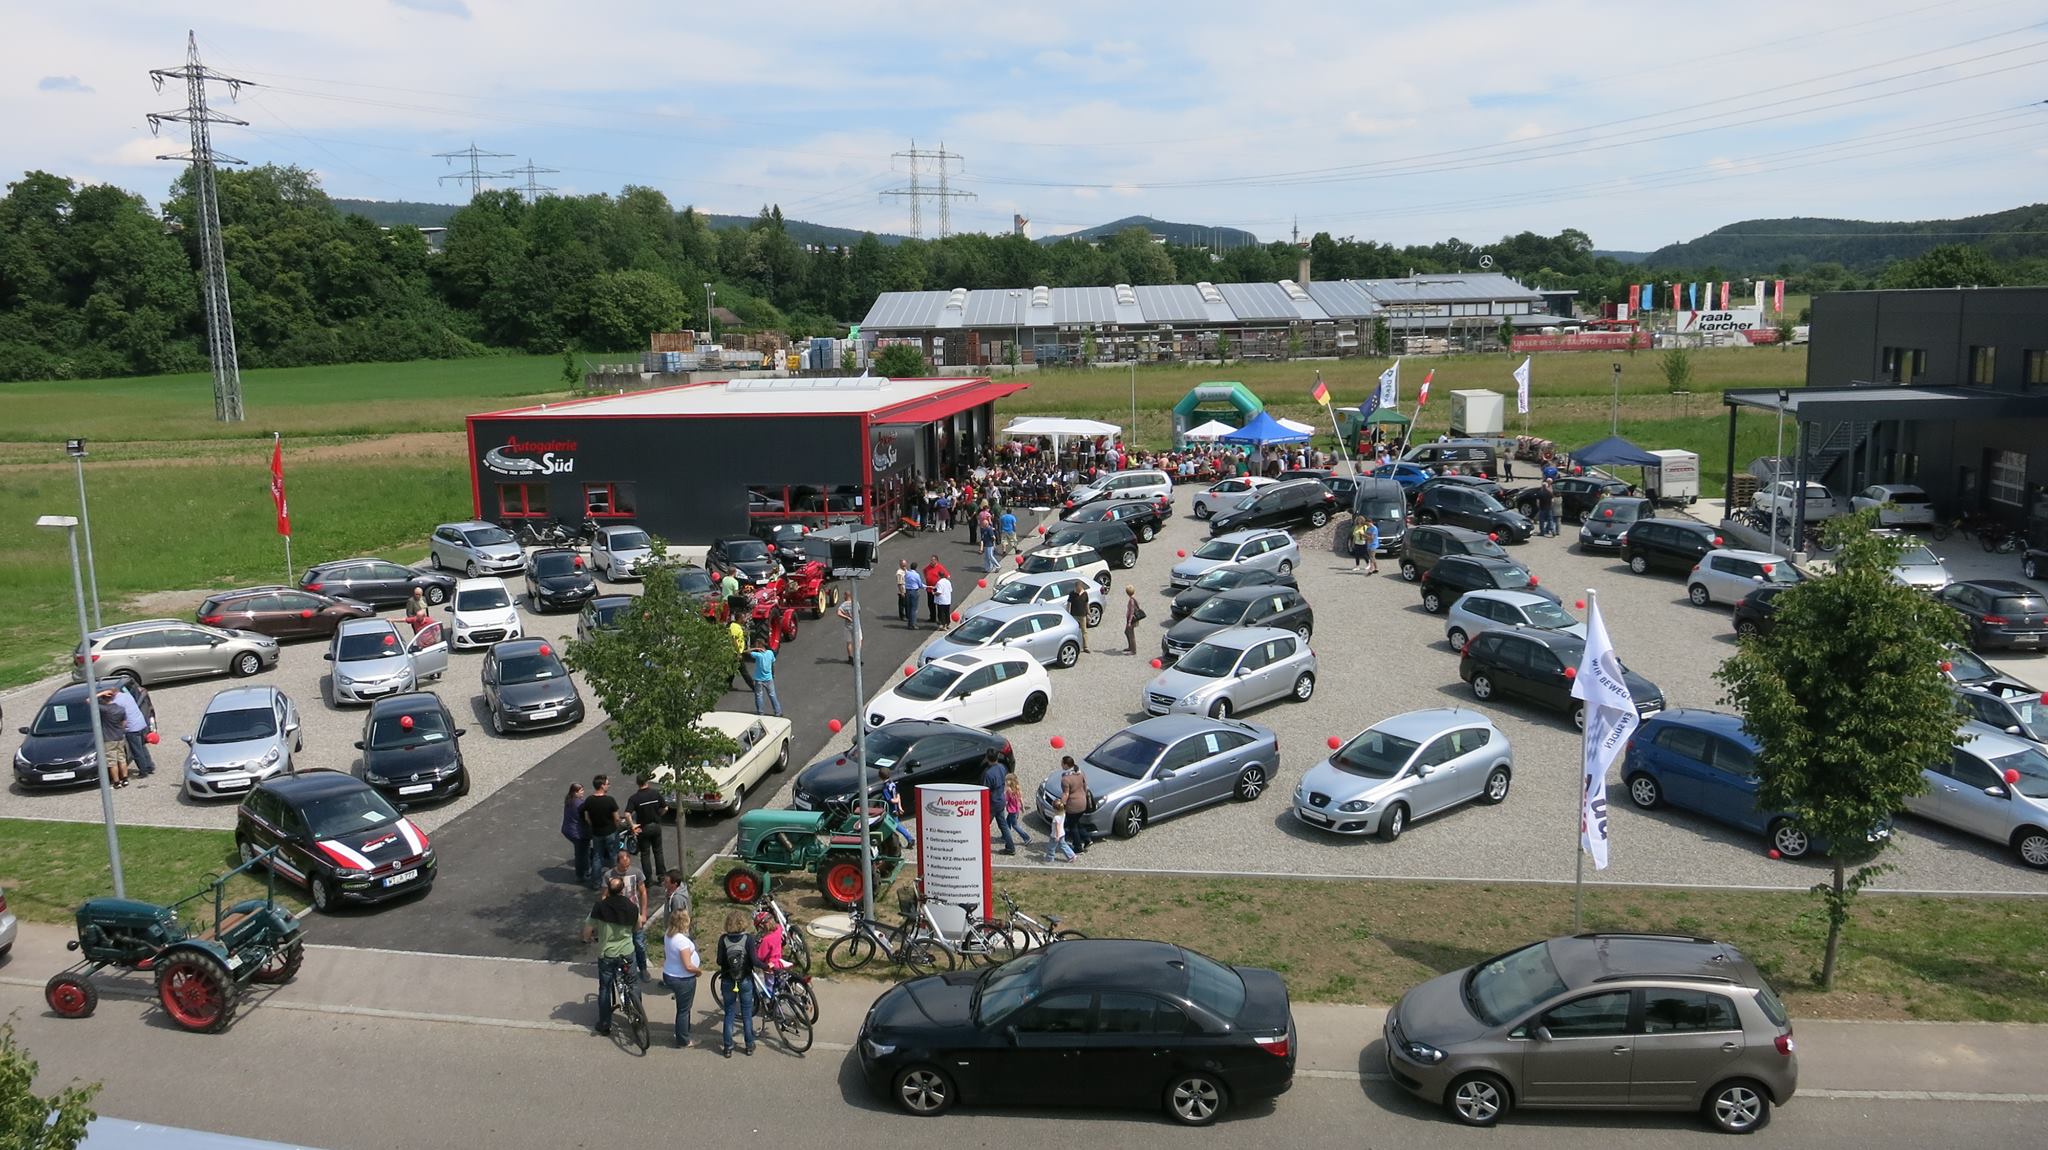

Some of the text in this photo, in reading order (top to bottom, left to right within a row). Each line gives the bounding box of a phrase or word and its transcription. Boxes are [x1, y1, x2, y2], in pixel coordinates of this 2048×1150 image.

[1701, 312, 1733, 321] raab
[1699, 322, 1753, 331] karcher
[1513, 339, 1538, 347] UNSER
[504, 435, 577, 454] Autogalerie
[542, 452, 574, 475] Süd
[1591, 658, 1603, 677] WIR
[937, 796, 978, 807] Autogalerie
[956, 806, 975, 817] Süd
